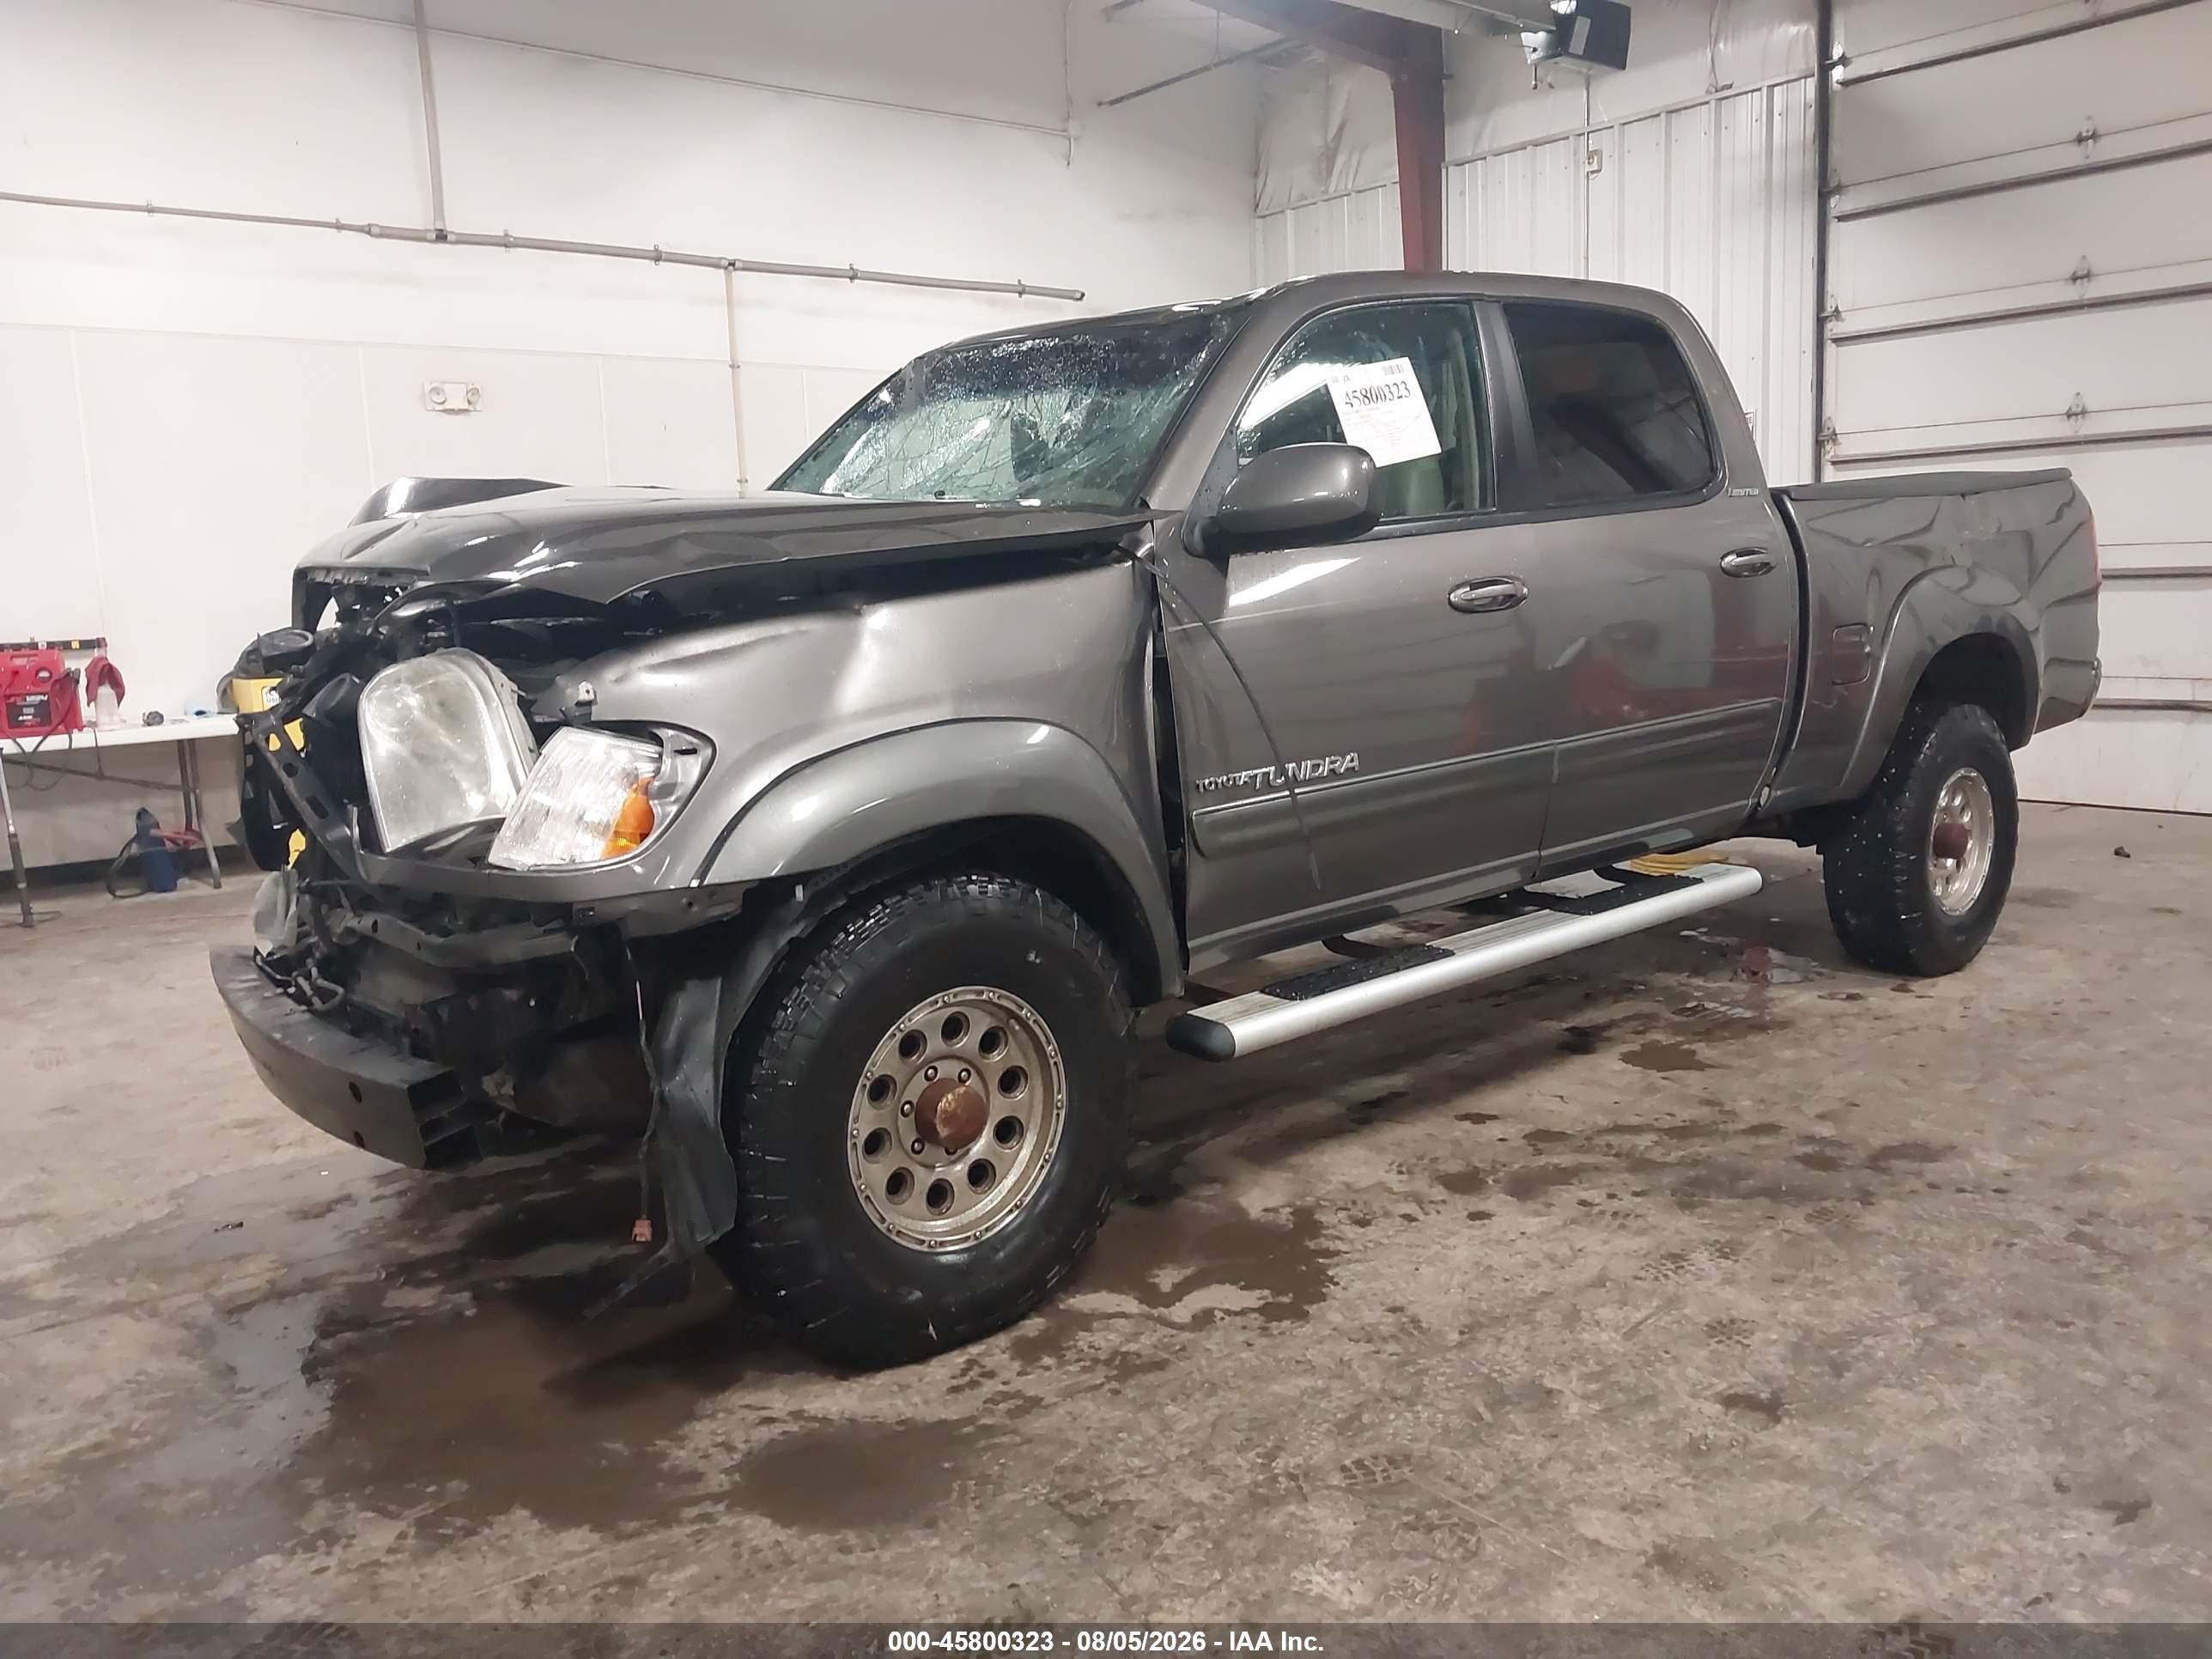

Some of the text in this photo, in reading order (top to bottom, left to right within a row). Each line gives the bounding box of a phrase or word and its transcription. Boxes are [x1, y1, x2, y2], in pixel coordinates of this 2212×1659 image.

[1345, 380, 1411, 407] 45800323
[1195, 751, 1359, 793] TOYOTA TUNDRA
